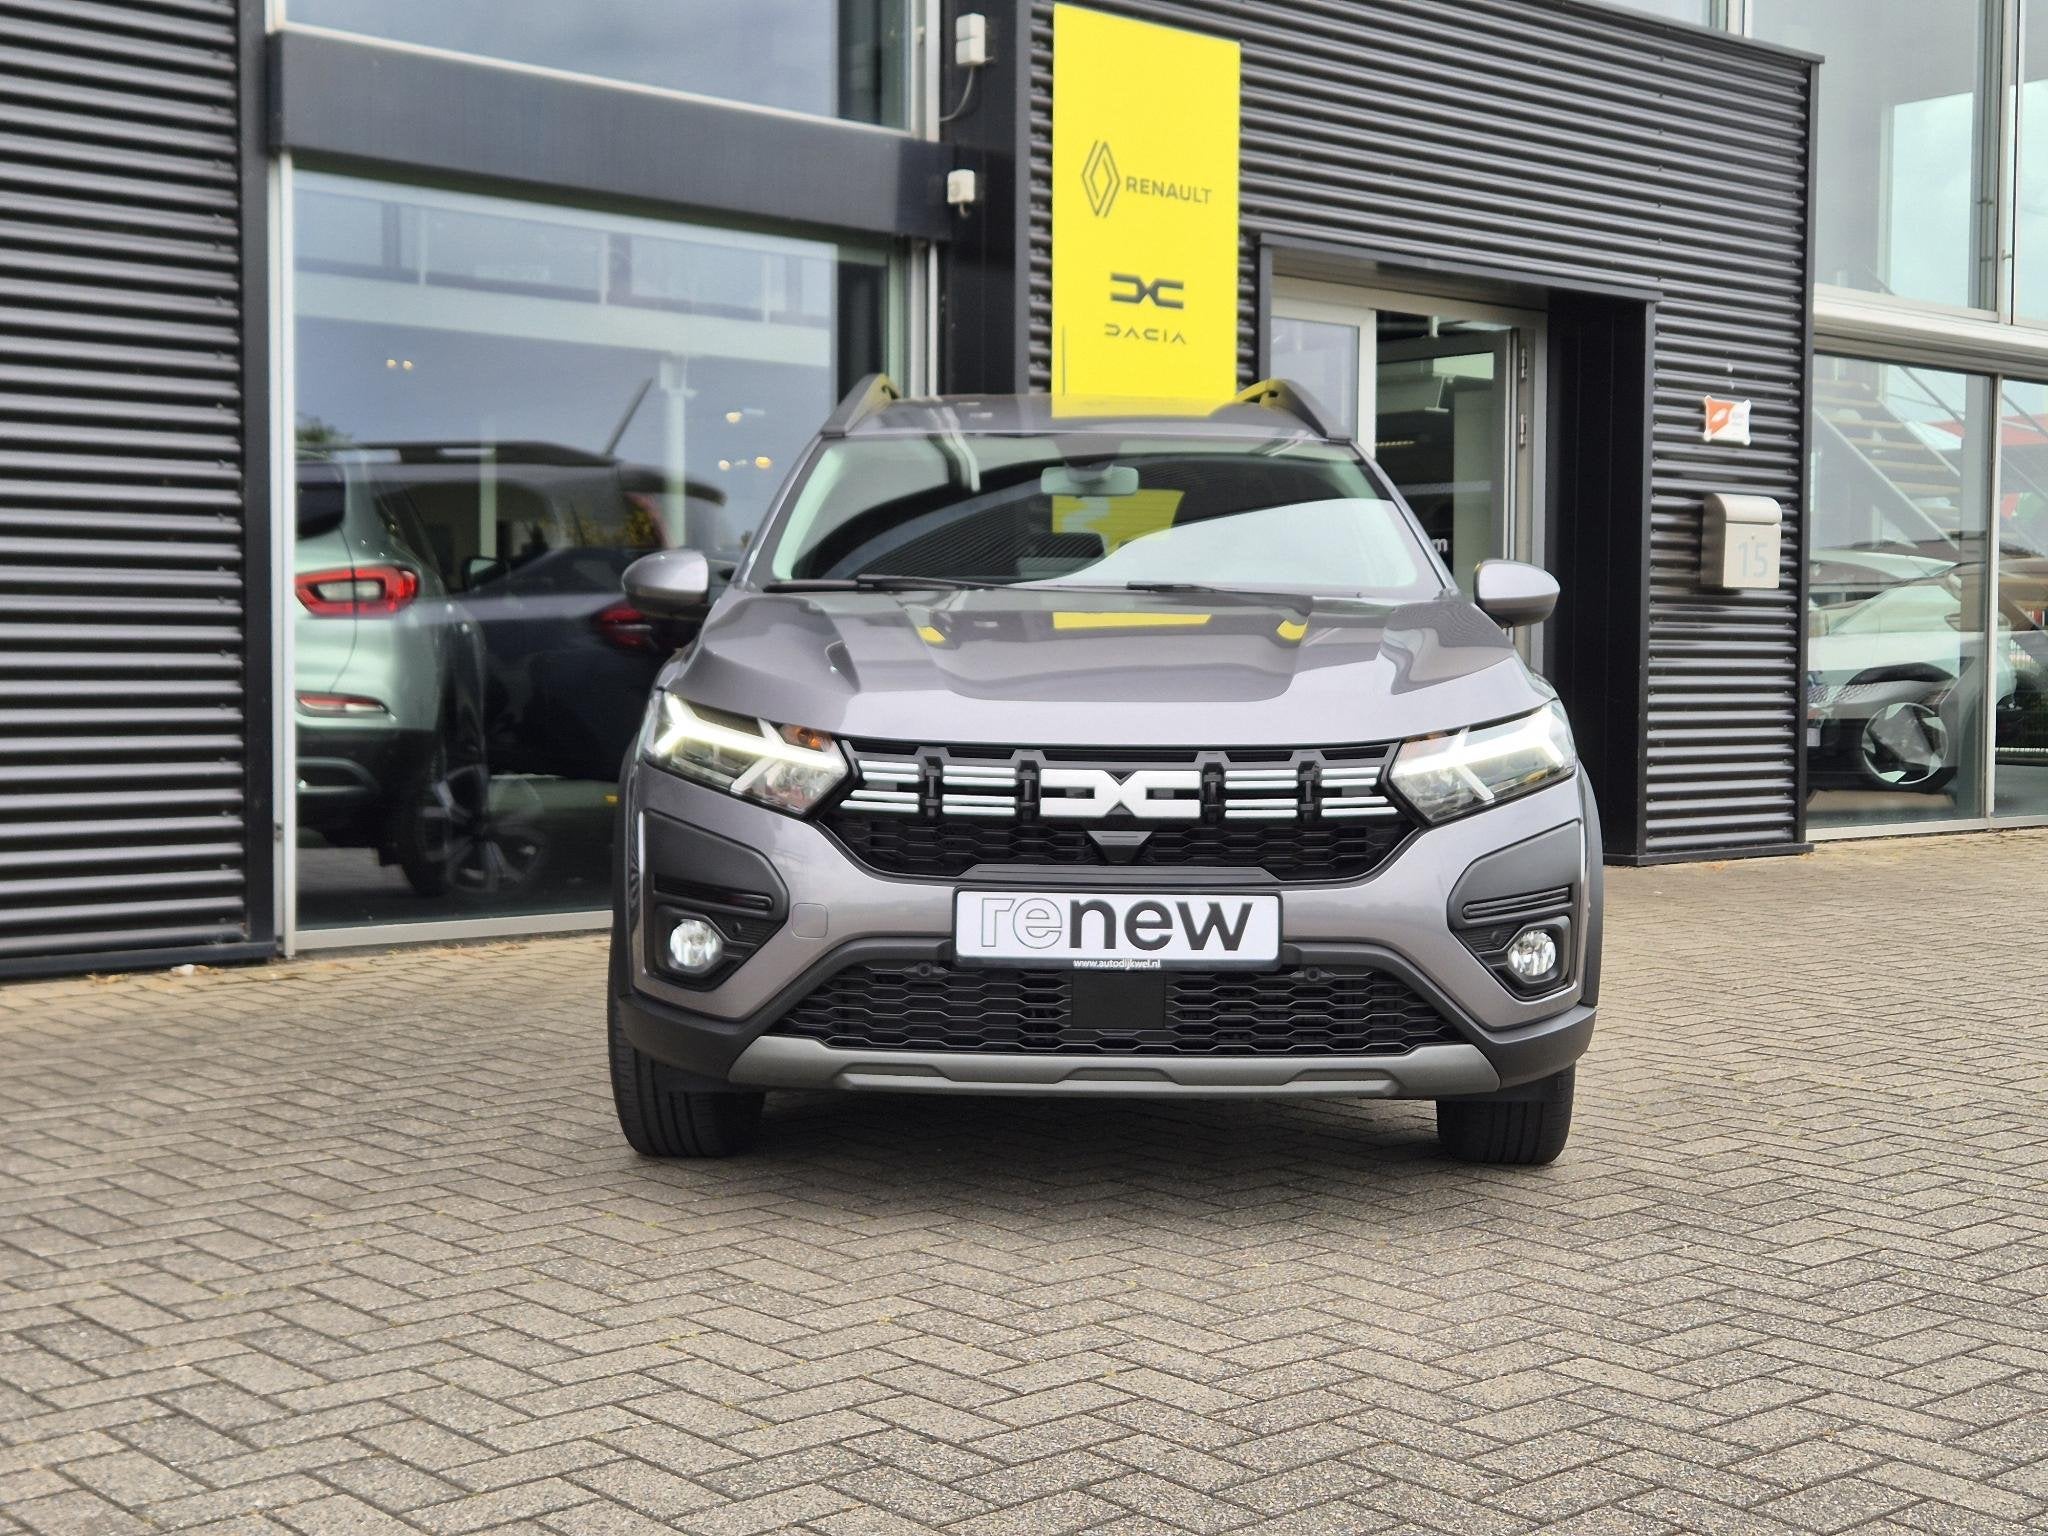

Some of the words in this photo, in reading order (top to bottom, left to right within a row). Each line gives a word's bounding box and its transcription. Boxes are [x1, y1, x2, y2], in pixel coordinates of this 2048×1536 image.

[1126, 176, 1212, 204] RENAULT
[1104, 323, 1187, 345] DACIA
[1738, 540, 1769, 578] 15
[980, 897, 1254, 952] renew
